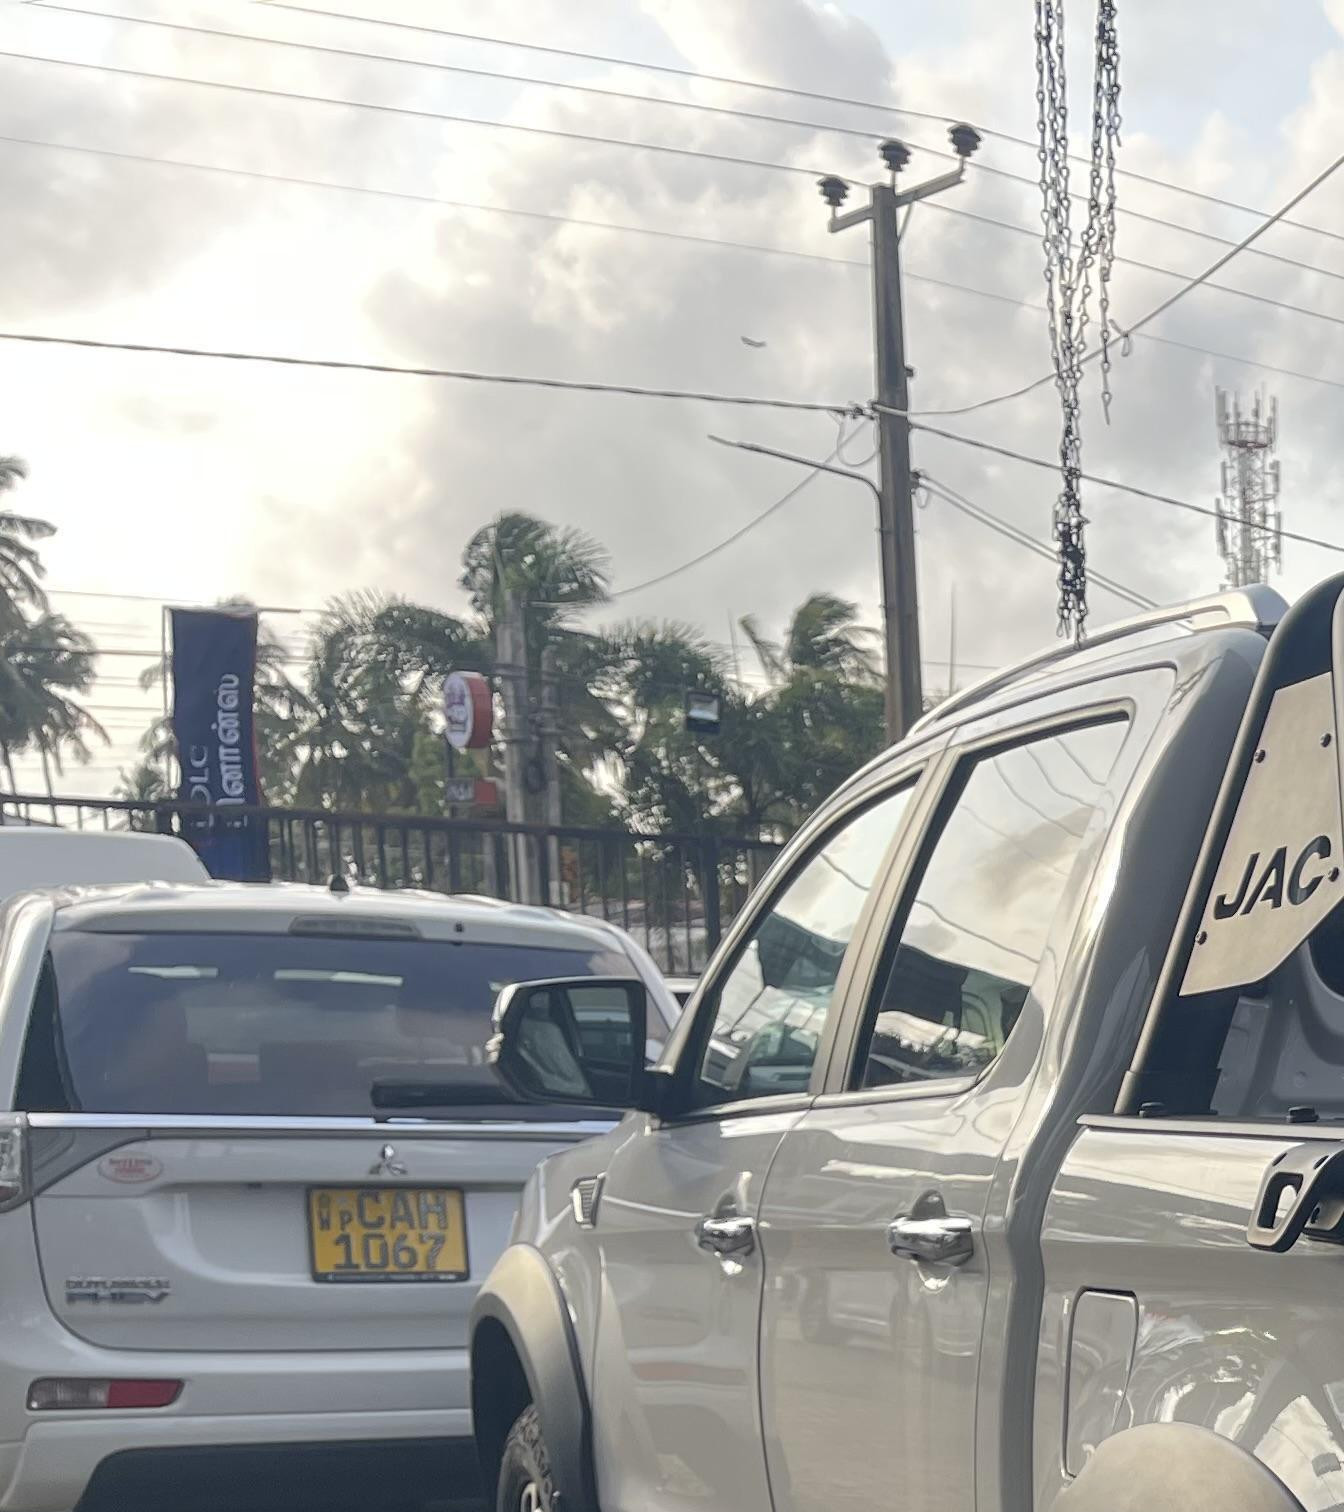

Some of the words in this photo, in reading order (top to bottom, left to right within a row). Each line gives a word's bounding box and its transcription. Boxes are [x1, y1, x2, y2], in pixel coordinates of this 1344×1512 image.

[1213, 835, 1332, 920] JAC
[357, 1191, 448, 1230] CAH
[334, 1232, 446, 1270] 1067
